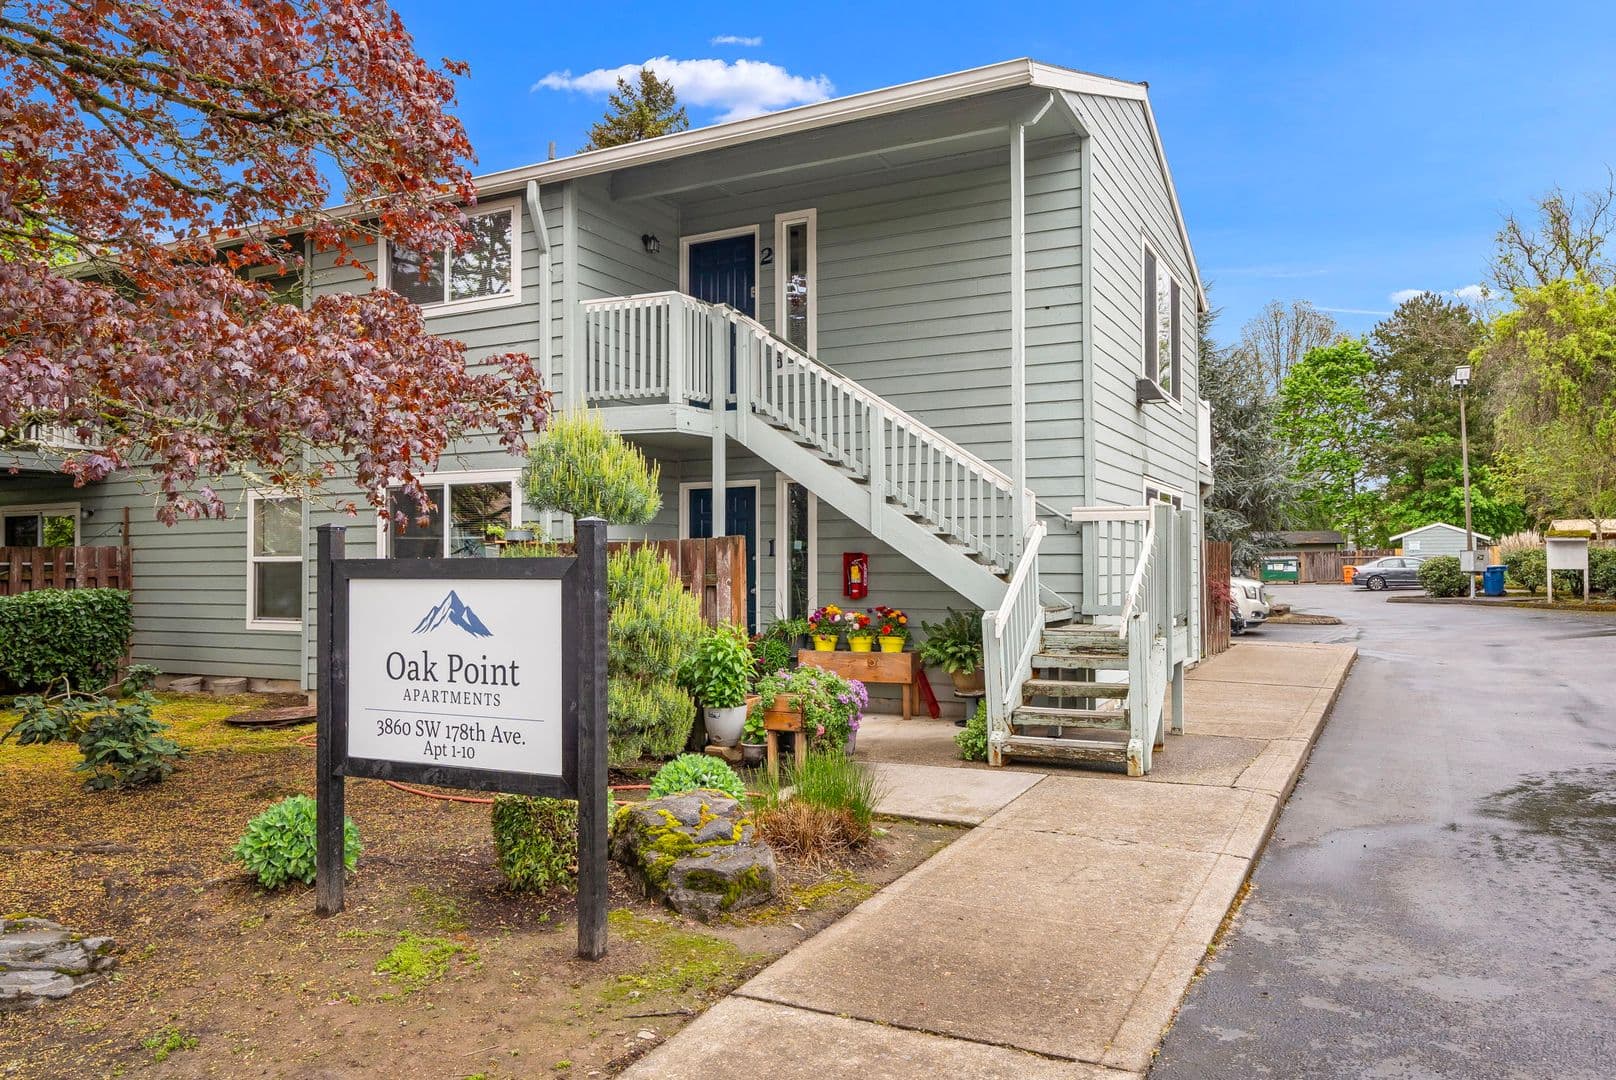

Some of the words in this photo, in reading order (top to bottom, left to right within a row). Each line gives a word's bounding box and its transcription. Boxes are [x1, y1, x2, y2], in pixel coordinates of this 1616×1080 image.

[760, 247, 773, 266] 2
[769, 539, 775, 557] 1
[386, 650, 439, 682] Oak
[447, 654, 521, 687] Point
[403, 688, 501, 707] APARTMENTS
[376, 718, 411, 736] 3860
[415, 719, 442, 738] SW
[445, 722, 486, 743] 178th
[490, 725, 526, 746] Ave.
[423, 740, 448, 760] Apt
[451, 745, 476, 760] 1-10
